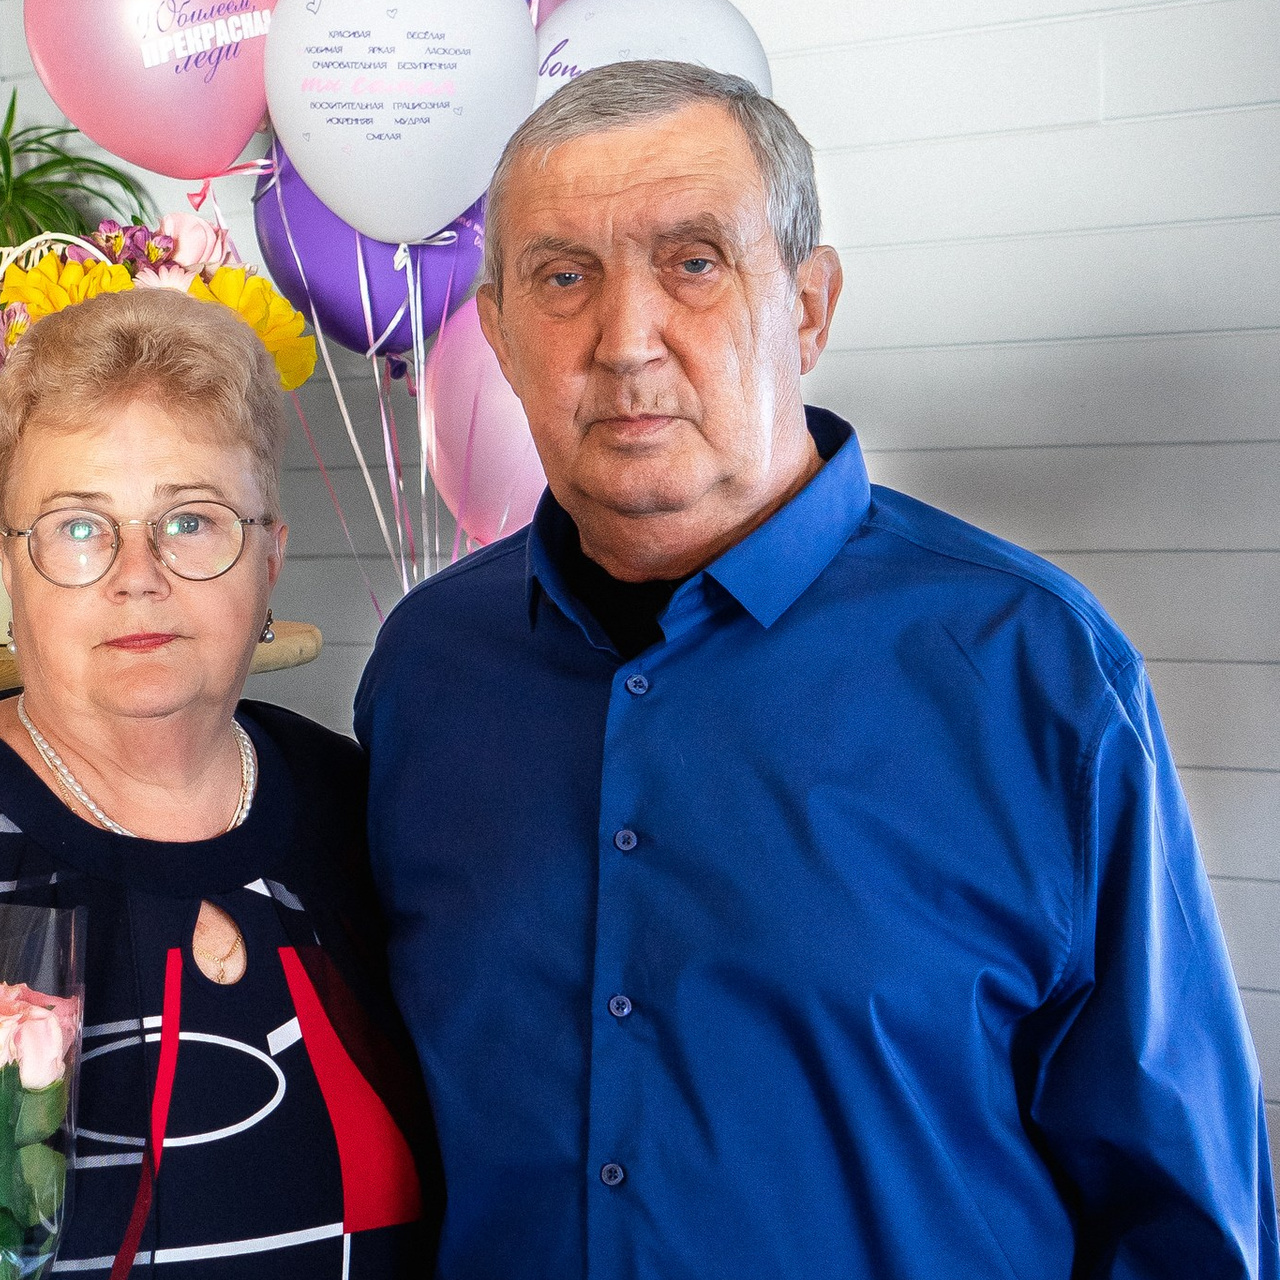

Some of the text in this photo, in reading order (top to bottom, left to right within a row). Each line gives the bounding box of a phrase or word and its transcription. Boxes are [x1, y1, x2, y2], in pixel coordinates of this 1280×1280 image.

[328, 30, 371, 39] КРАСИВАЯ
[304, 45, 471, 56] ЛЮБИМАЯ ЯРКАЯ ЛАСКОВАЯ
[175, 42, 240, 83] леди
[312, 60, 457, 70] ОЧАРОВАТЕЛЬНАЯ БЕЗУПРЕЧНАЯ
[310, 101, 450, 110] ВОСХИТИТЕЛЬНАЯ ГРАЦИОЗНАЯ
[394, 117, 430, 125] МУДРАЯ
[365, 132, 402, 141] СМЕЛАЯ
